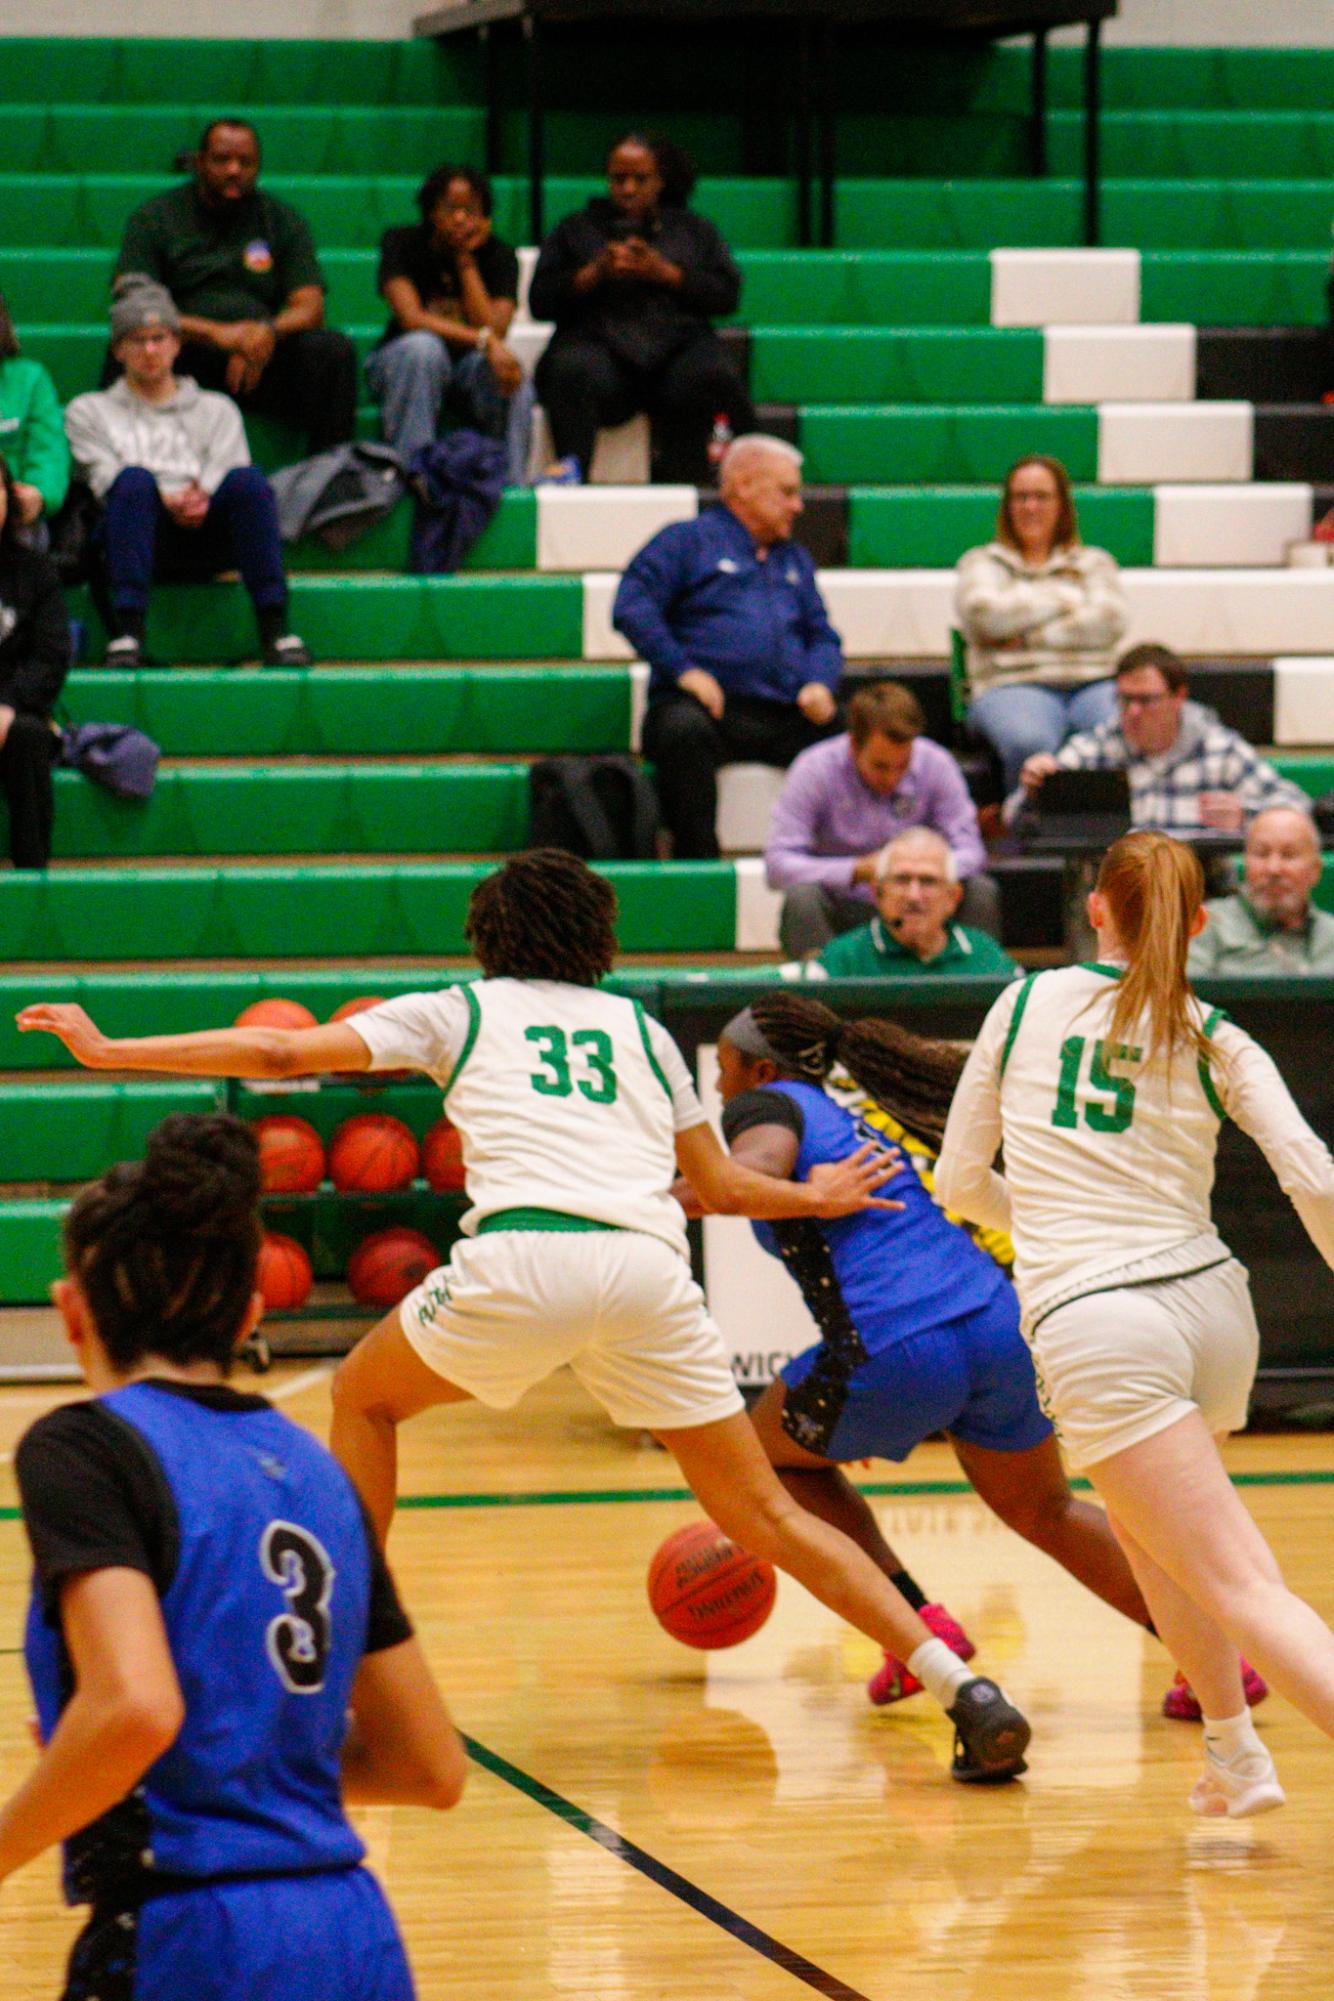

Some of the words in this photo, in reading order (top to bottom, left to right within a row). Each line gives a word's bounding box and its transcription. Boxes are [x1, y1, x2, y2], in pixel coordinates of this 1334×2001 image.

[523, 1024, 618, 1105] 33
[1051, 1034, 1143, 1134] 15
[259, 1519, 336, 1694] 3
